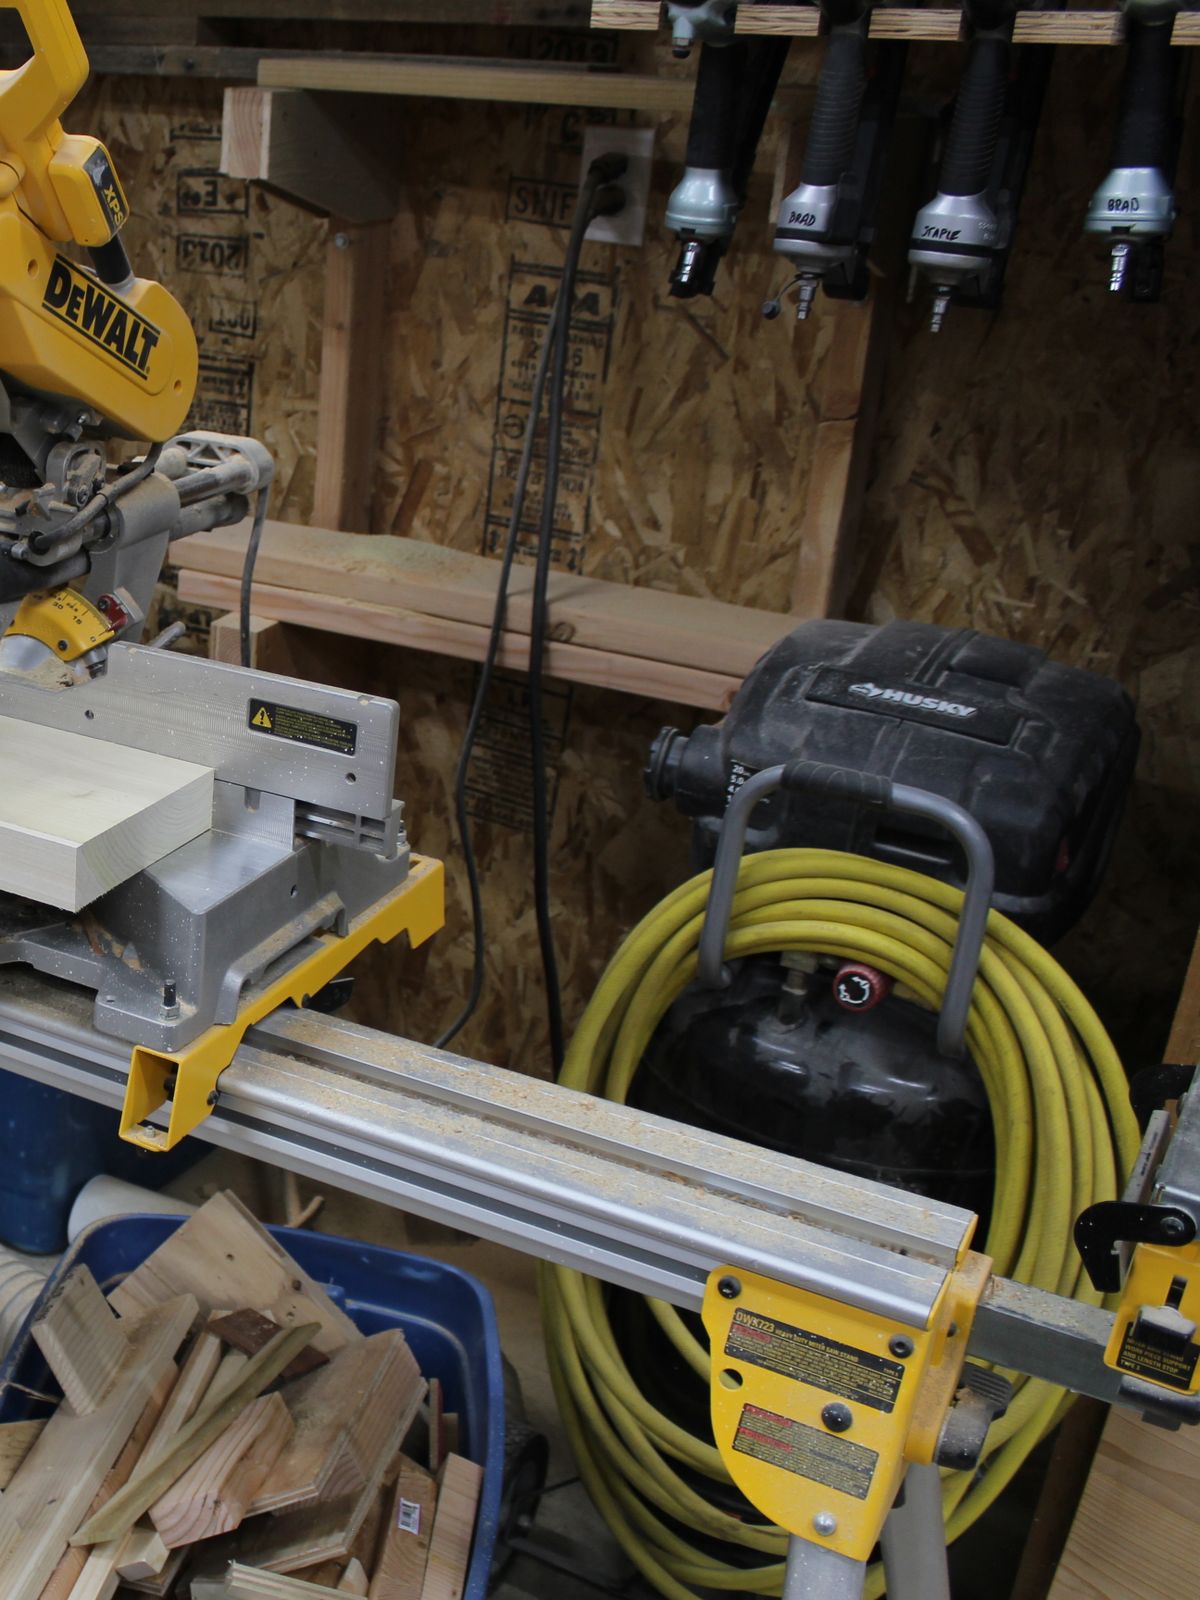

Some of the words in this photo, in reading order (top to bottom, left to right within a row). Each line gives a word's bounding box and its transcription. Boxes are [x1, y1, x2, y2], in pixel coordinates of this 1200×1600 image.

[103, 183, 125, 226] XPS
[1107, 197, 1140, 212] BRAD
[787, 210, 817, 227] BRAD
[921, 225, 962, 241] STAPLE
[523, 284, 600, 316] AA
[882, 688, 978, 718] HUSKY
[735, 1311, 776, 1333] DWX723
